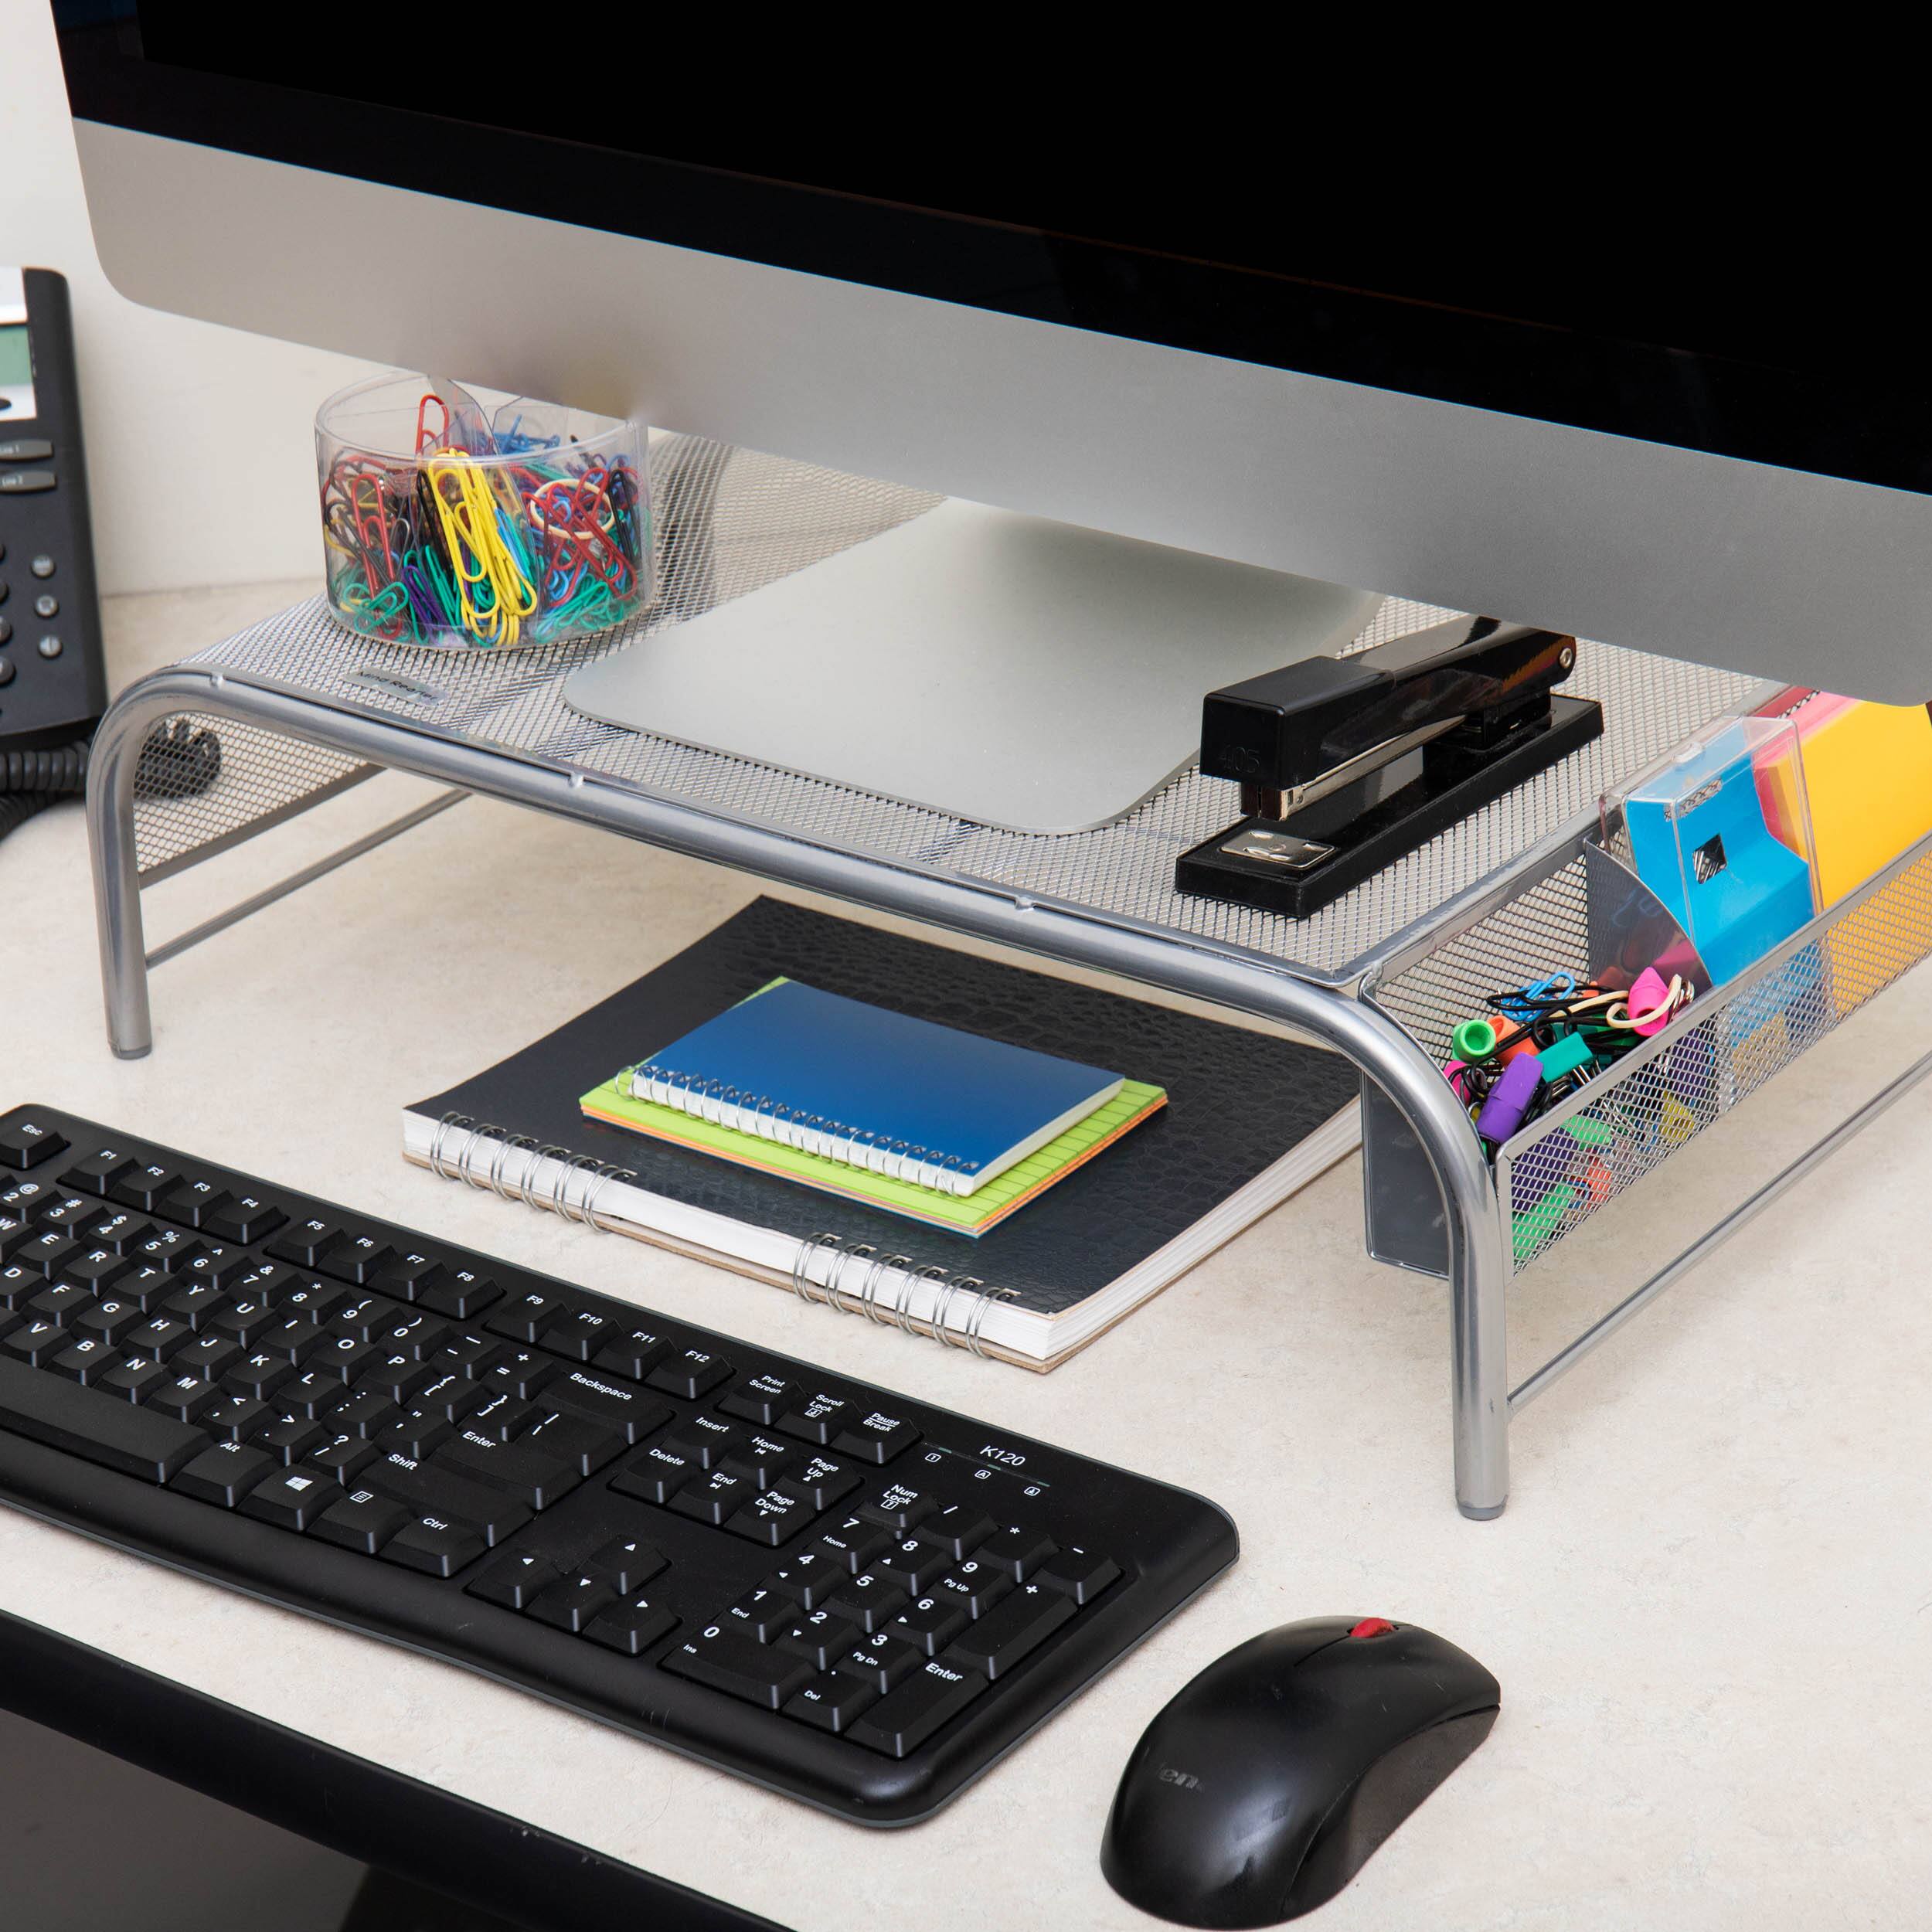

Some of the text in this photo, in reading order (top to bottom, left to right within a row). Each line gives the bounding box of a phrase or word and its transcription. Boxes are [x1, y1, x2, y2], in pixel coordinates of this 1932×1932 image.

[356, 671, 389, 683] Mind
[1218, 744, 1260, 773] 405
[22, 1124, 43, 1135] Esc
[100, 1151, 117, 1159] F1
[148, 1167, 164, 1176] F2
[19, 1184, 39, 1194] @
[194, 1182, 210, 1192] F3
[3, 1192, 19, 1202] 2
[66, 1199, 82, 1208] #
[242, 1199, 258, 1207] F4
[50, 1209, 65, 1217] 3
[0, 1218, 16, 1230] W
[112, 1216, 127, 1225] $
[308, 1221, 325, 1230] F5
[99, 1224, 113, 1235] 4
[41, 1234, 59, 1244] E
[162, 1231, 179, 1243] %
[357, 1238, 373, 1247] F6
[145, 1241, 161, 1250] 5
[89, 1251, 107, 1262] R
[407, 1255, 425, 1264] F7
[194, 1259, 208, 1267] 6
[5, 1267, 22, 1277] D
[140, 1268, 155, 1277] T
[260, 1266, 274, 1275] &
[457, 1272, 474, 1281] F8
[189, 1285, 204, 1294] Y
[292, 1293, 307, 1301] 8
[527, 1295, 543, 1304] F9
[103, 1303, 120, 1312] G
[236, 1303, 254, 1313] U
[343, 1310, 357, 1318] 9
[579, 1314, 602, 1325] F10
[31, 1323, 47, 1333] V
[151, 1319, 170, 1330] H
[633, 1332, 655, 1343] F11
[77, 1341, 94, 1351] B
[338, 1339, 355, 1349] O
[250, 1355, 269, 1366] K
[685, 1350, 709, 1362] F12
[126, 1359, 146, 1370] N
[177, 1377, 198, 1389] M
[302, 1373, 314, 1384] L
[761, 1375, 785, 1387] Print
[570, 1373, 631, 1400] Backspace
[749, 1379, 781, 1394] Screen
[815, 1394, 845, 1407] Scroll
[809, 1400, 833, 1413] Lock
[696, 1417, 729, 1432] Insert
[871, 1413, 900, 1426] Pause
[862, 1419, 892, 1433] Break
[334, 1435, 349, 1444] ?
[463, 1431, 496, 1447] Enter
[751, 1437, 784, 1452] Home
[219, 1441, 240, 1453] Alt
[649, 1449, 685, 1465] Delete
[979, 1445, 1026, 1467] K120
[388, 1453, 417, 1471] Shift
[811, 1458, 839, 1472] Page
[712, 1472, 736, 1485] End
[806, 1468, 824, 1478] Up
[891, 1484, 919, 1498] Num
[766, 1491, 795, 1506] Page
[883, 1491, 912, 1505] Lock
[755, 1498, 787, 1514] Down
[423, 1519, 447, 1529] Ctrl
[843, 1518, 859, 1528] 7
[823, 1536, 846, 1548] Home
[903, 1541, 918, 1551] 8
[799, 1555, 815, 1564] 4
[962, 1562, 978, 1573] 9
[857, 1576, 874, 1586] 5
[944, 1578, 969, 1593] Pg Up
[754, 1591, 767, 1600] 1
[918, 1599, 934, 1609] 6
[732, 1608, 750, 1617] End
[810, 1612, 827, 1624] 2
[704, 1627, 719, 1638] 0
[872, 1634, 887, 1645] 3
[683, 1645, 696, 1653] Ins
[852, 1651, 878, 1666] Pg Dn
[926, 1663, 963, 1681] Enter
[804, 1690, 821, 1700] Del
